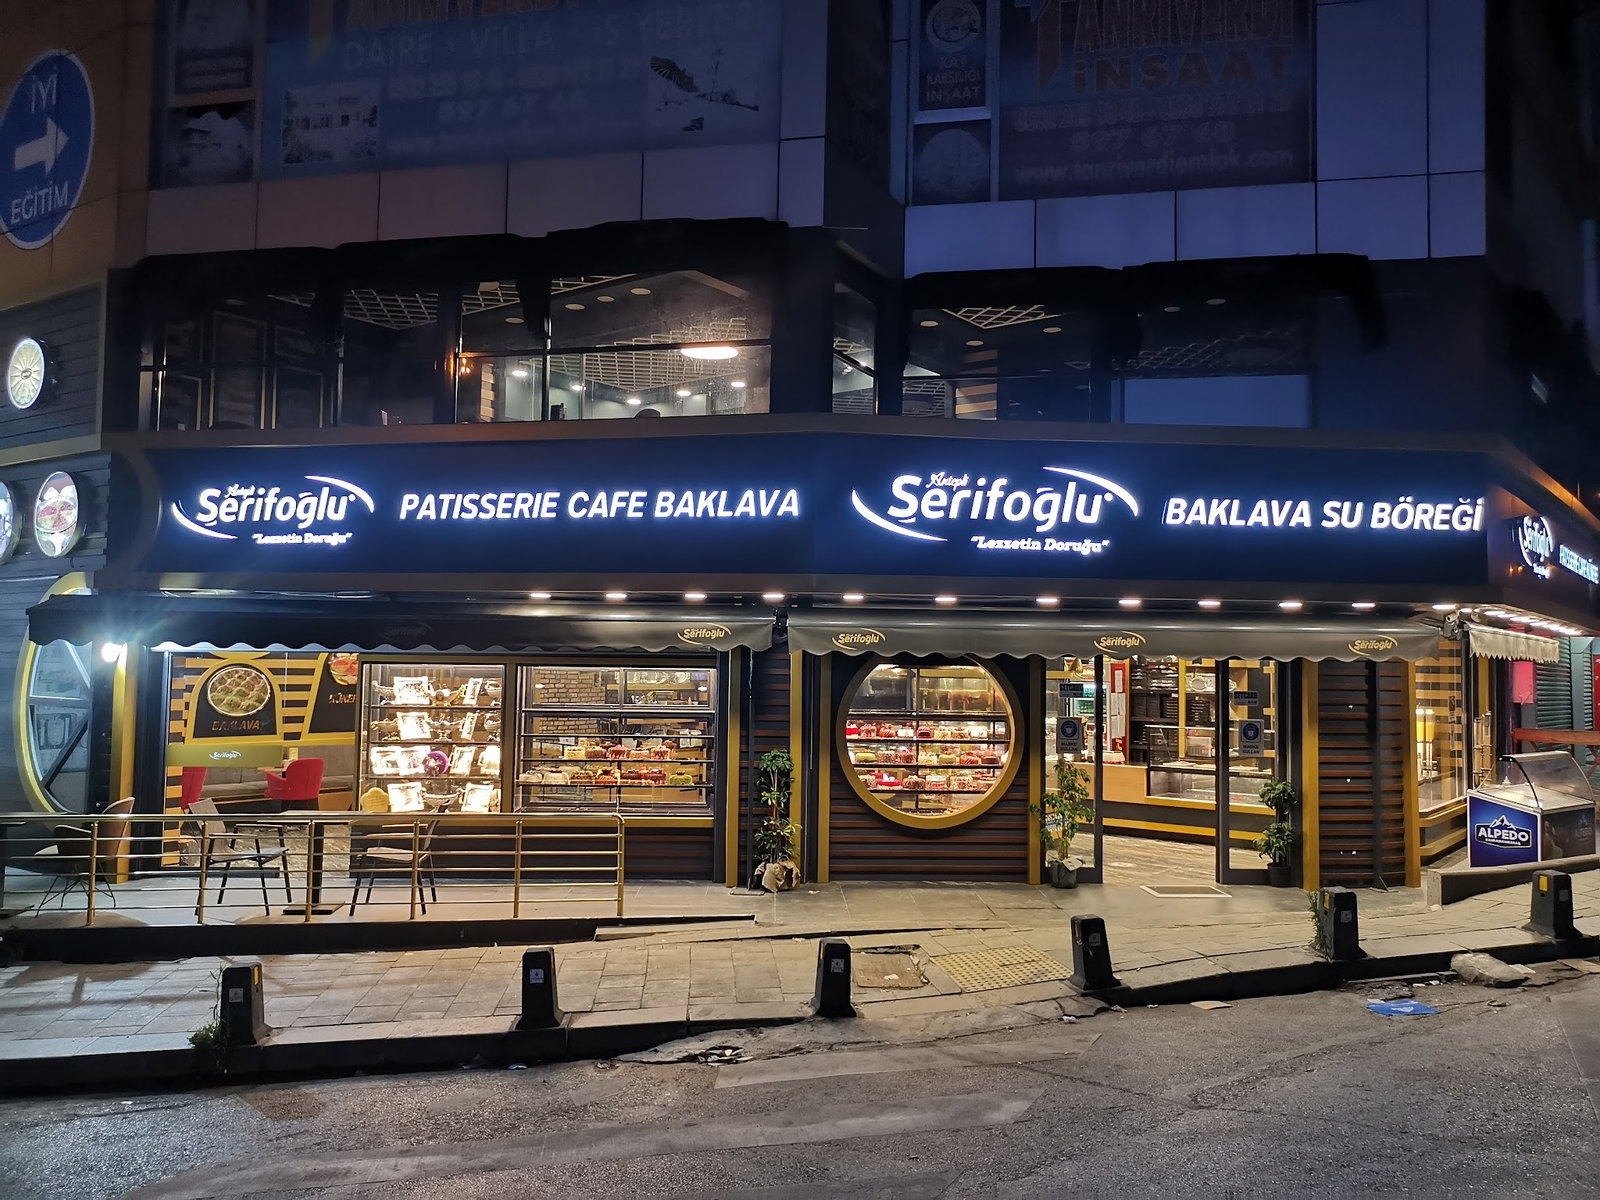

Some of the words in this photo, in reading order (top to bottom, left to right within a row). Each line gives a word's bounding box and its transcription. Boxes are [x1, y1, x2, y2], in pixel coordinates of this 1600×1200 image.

[10, 180, 69, 225] EĞİTİM
[399, 492, 561, 520] PATISSERIE
[567, 491, 648, 519] CAFE
[653, 489, 800, 518] BAKLAVA
[1163, 497, 1312, 528] BAKLAVA
[1320, 500, 1364, 529] SU
[1369, 496, 1485, 531] BÖREĞİ
[1478, 826, 1529, 842] ALPEDO
